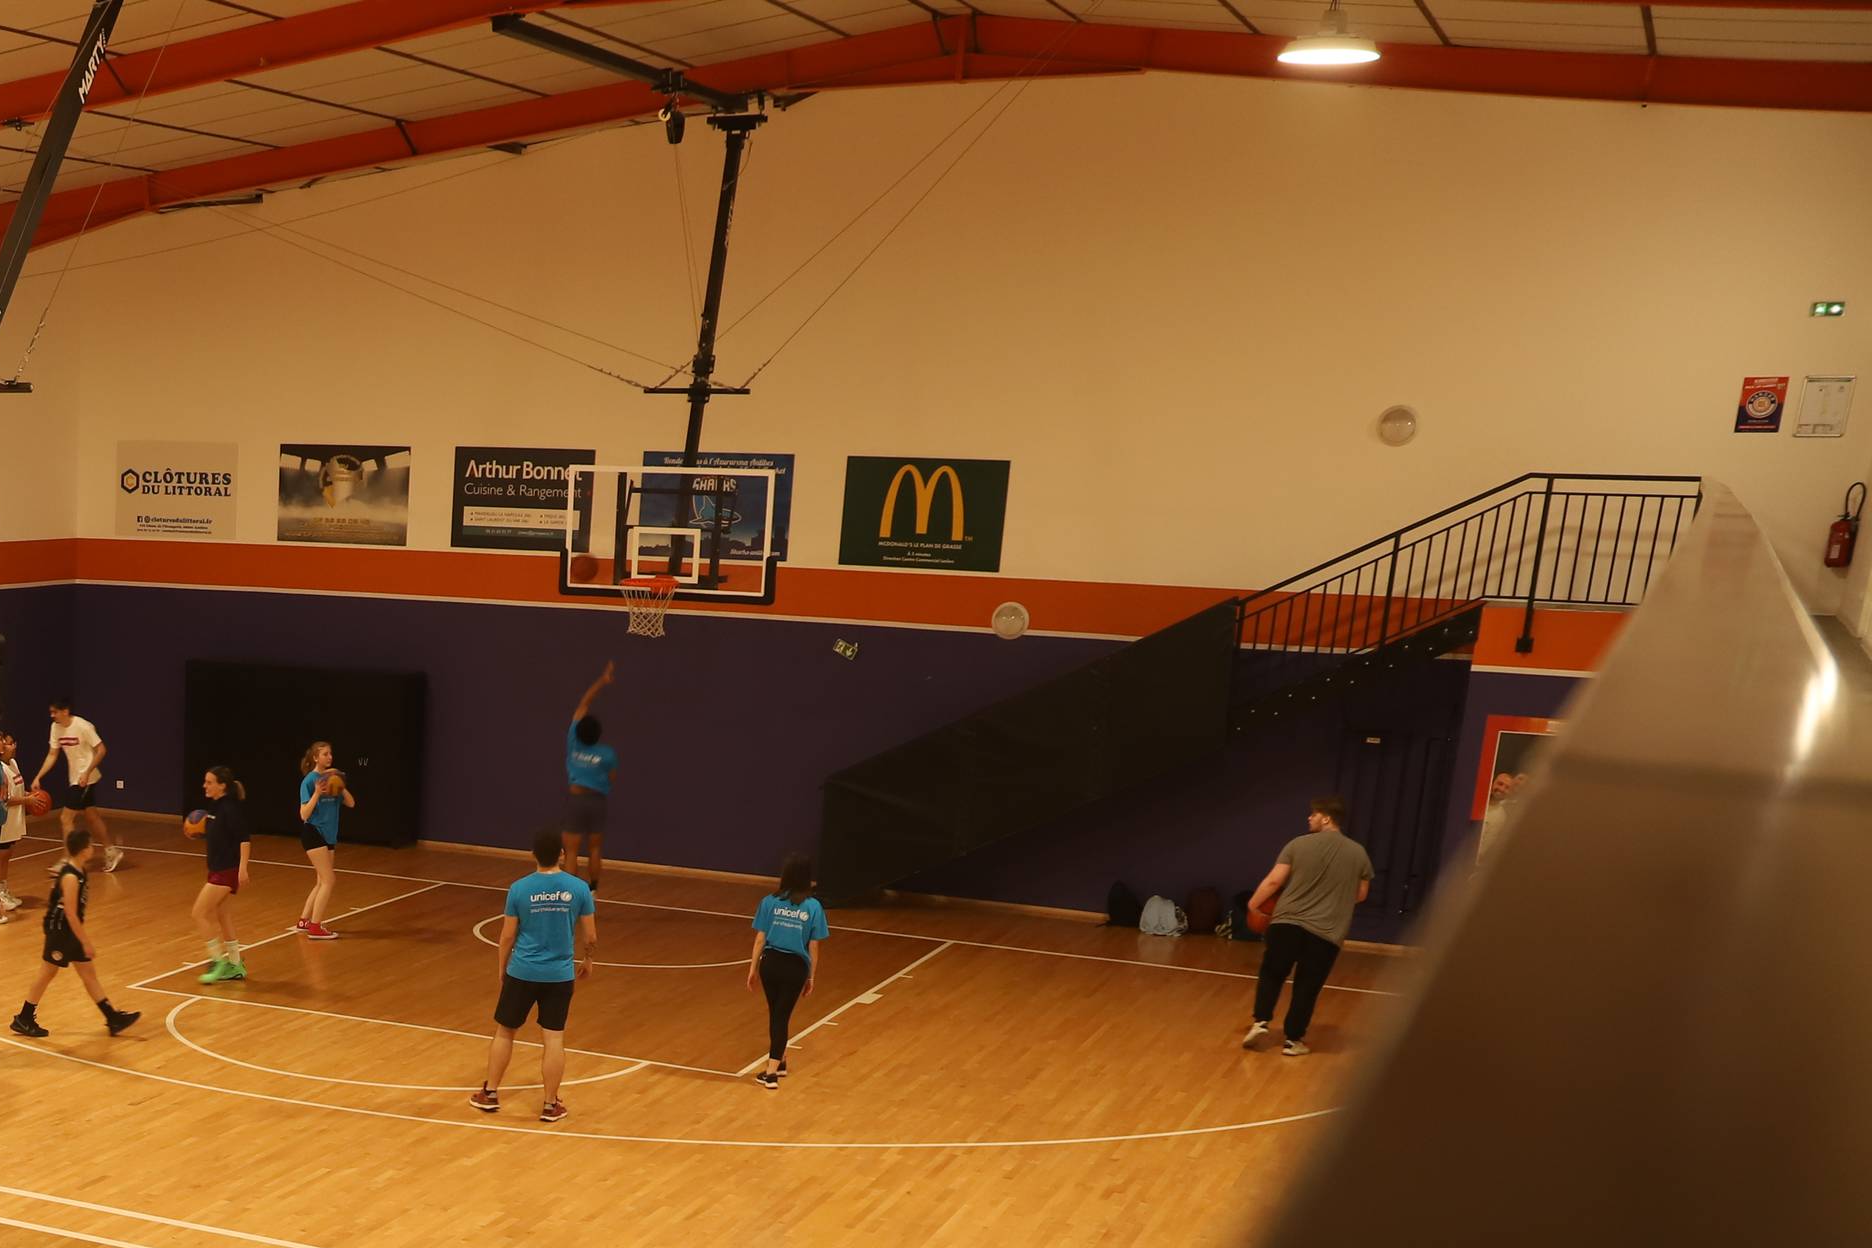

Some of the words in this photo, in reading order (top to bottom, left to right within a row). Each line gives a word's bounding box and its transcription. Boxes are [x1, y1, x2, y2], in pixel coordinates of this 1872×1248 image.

[78, 32, 105, 105] MARTY
[142, 467, 232, 486] CLÔTURES
[465, 460, 521, 479] Arthur
[142, 485, 161, 495] DU
[164, 486, 232, 497] LITTORAL
[464, 482, 504, 496] Cuisine
[506, 484, 516, 496] &
[530, 891, 561, 902] unicef
[774, 907, 801, 918] unicef
